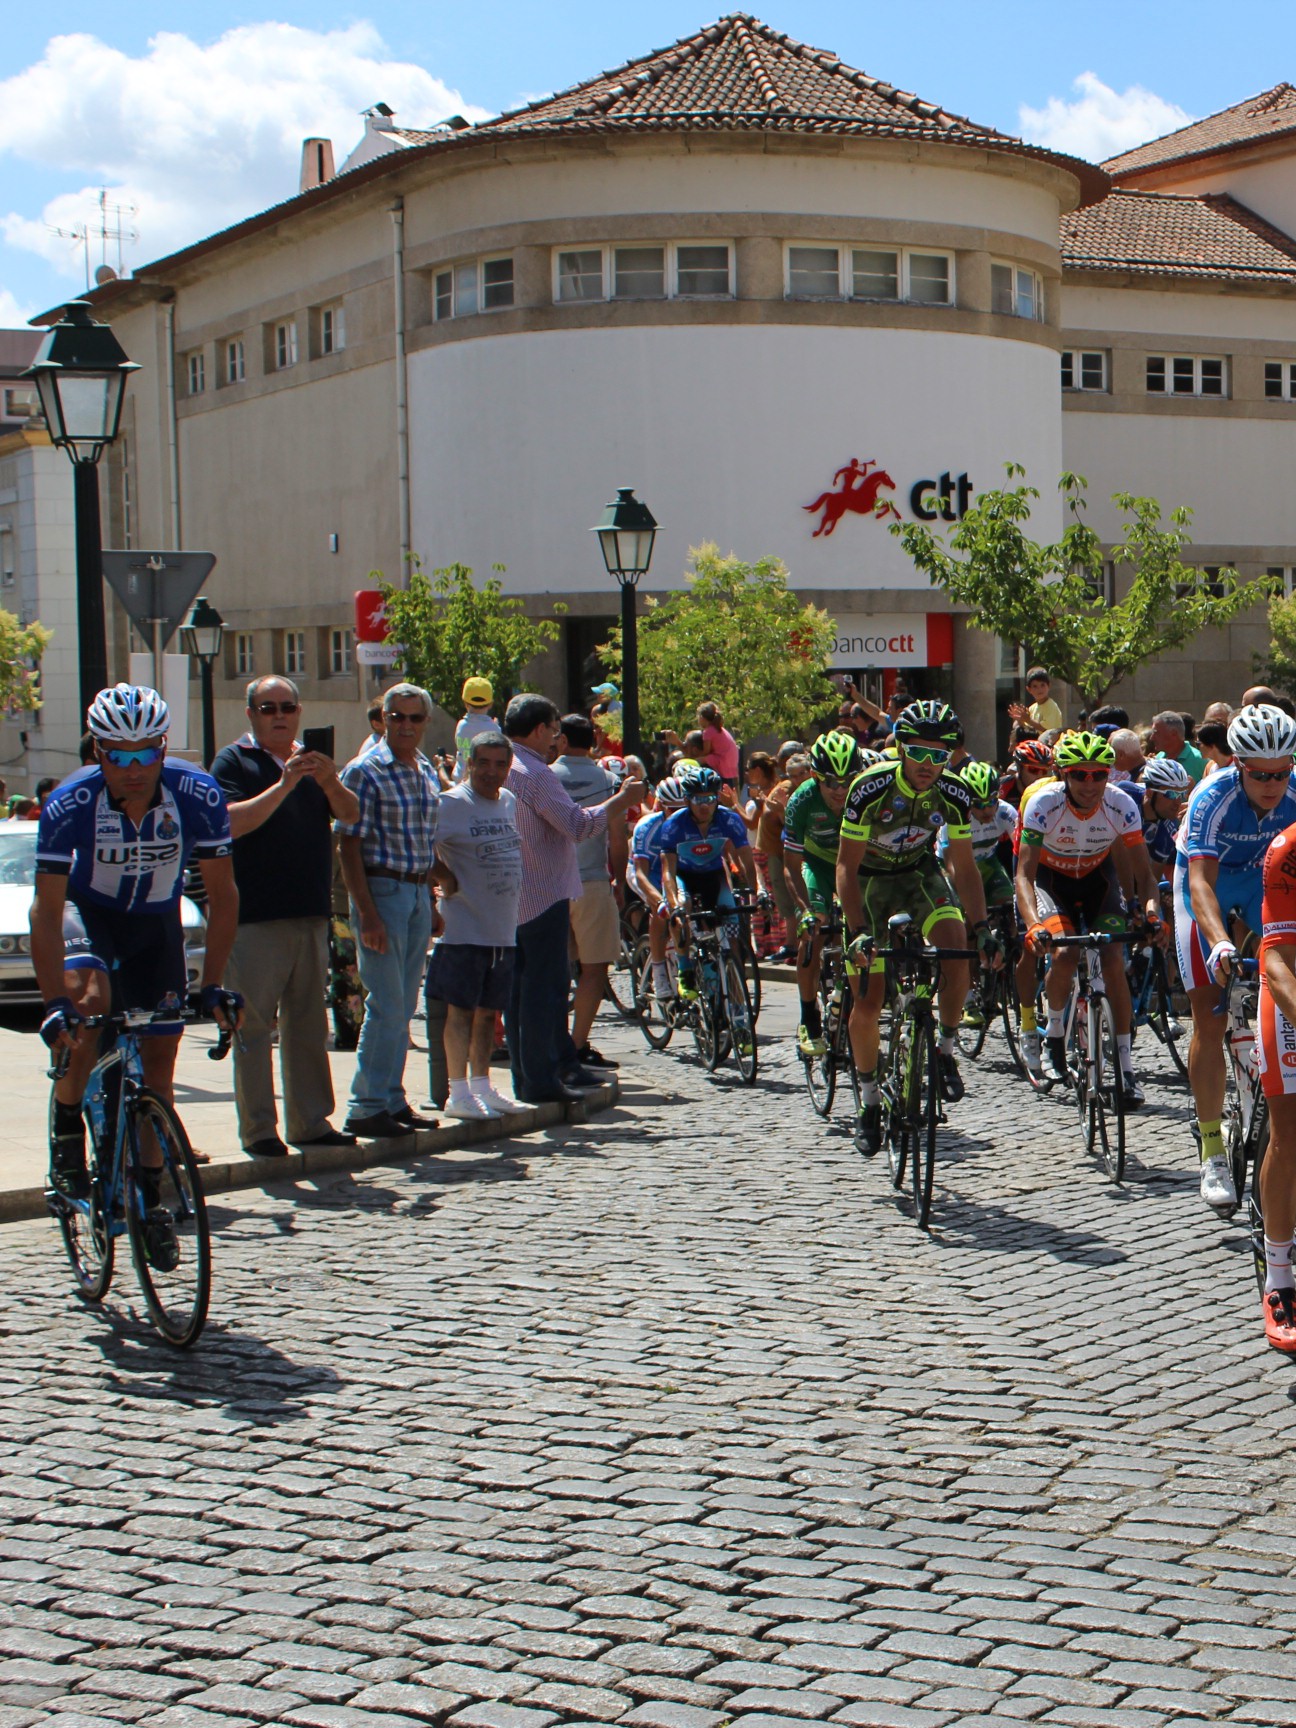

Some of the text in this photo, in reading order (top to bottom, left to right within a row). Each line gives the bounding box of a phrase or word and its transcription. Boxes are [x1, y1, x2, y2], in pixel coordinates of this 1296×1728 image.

[909, 471, 973, 521] ctt
[47, 787, 92, 820] MEO
[178, 775, 220, 808] MEO
[851, 773, 894, 806] ŠKODA
